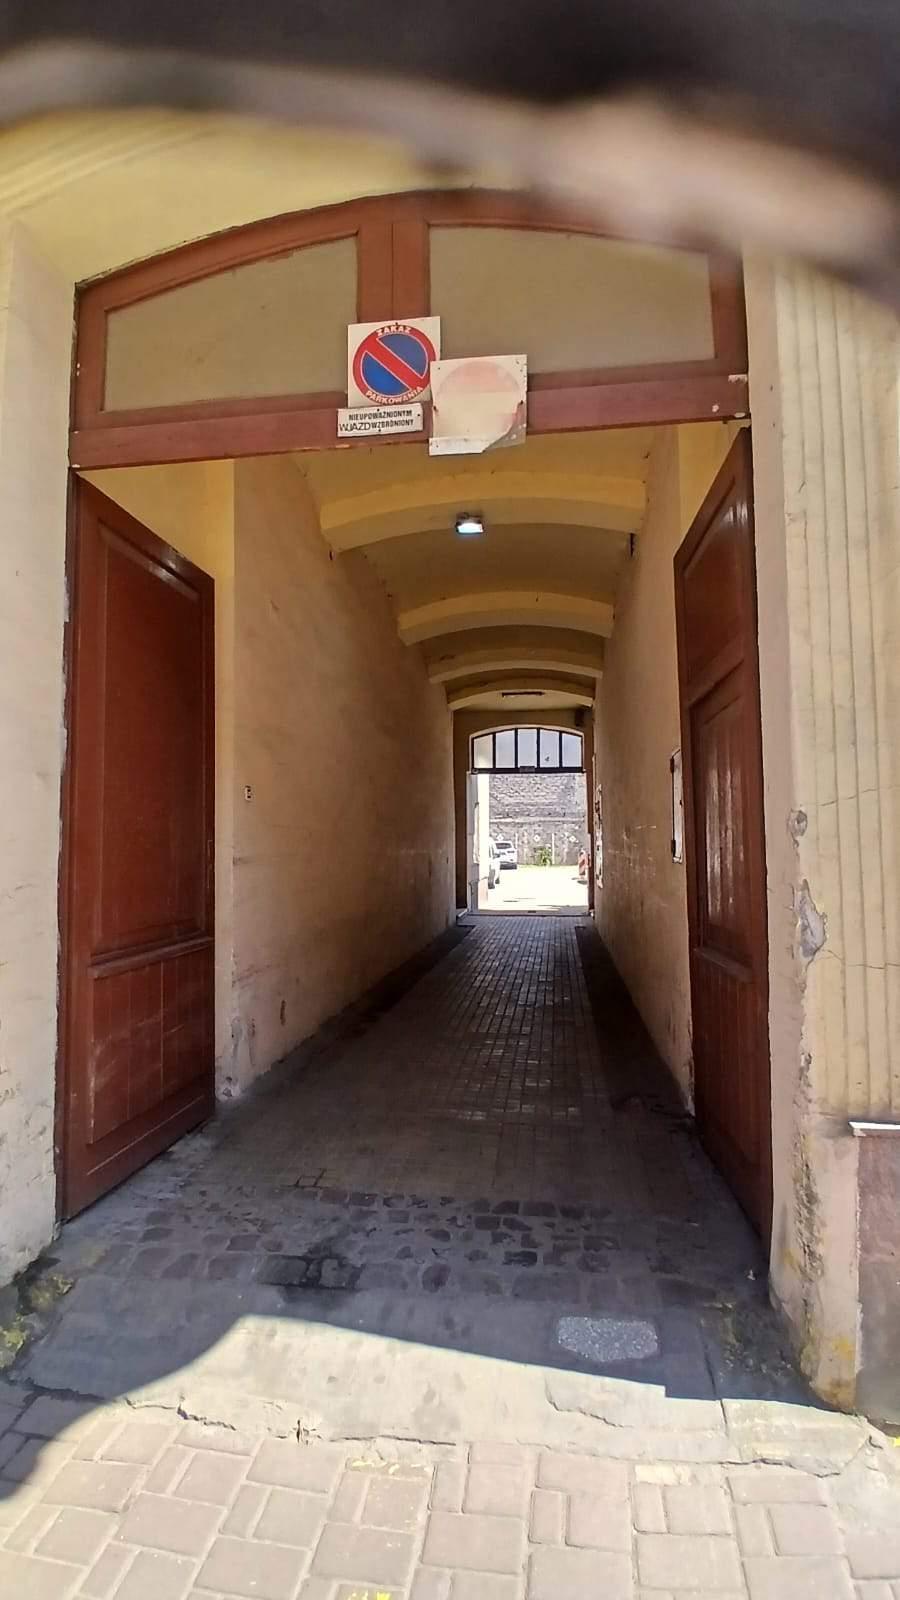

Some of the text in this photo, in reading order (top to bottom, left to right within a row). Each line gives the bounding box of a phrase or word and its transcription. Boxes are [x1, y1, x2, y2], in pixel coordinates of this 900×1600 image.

[376, 326, 411, 336] ZAKAZ
[366, 386, 423, 404] PARKOWANIA
[339, 422, 371, 432] WJAZD
